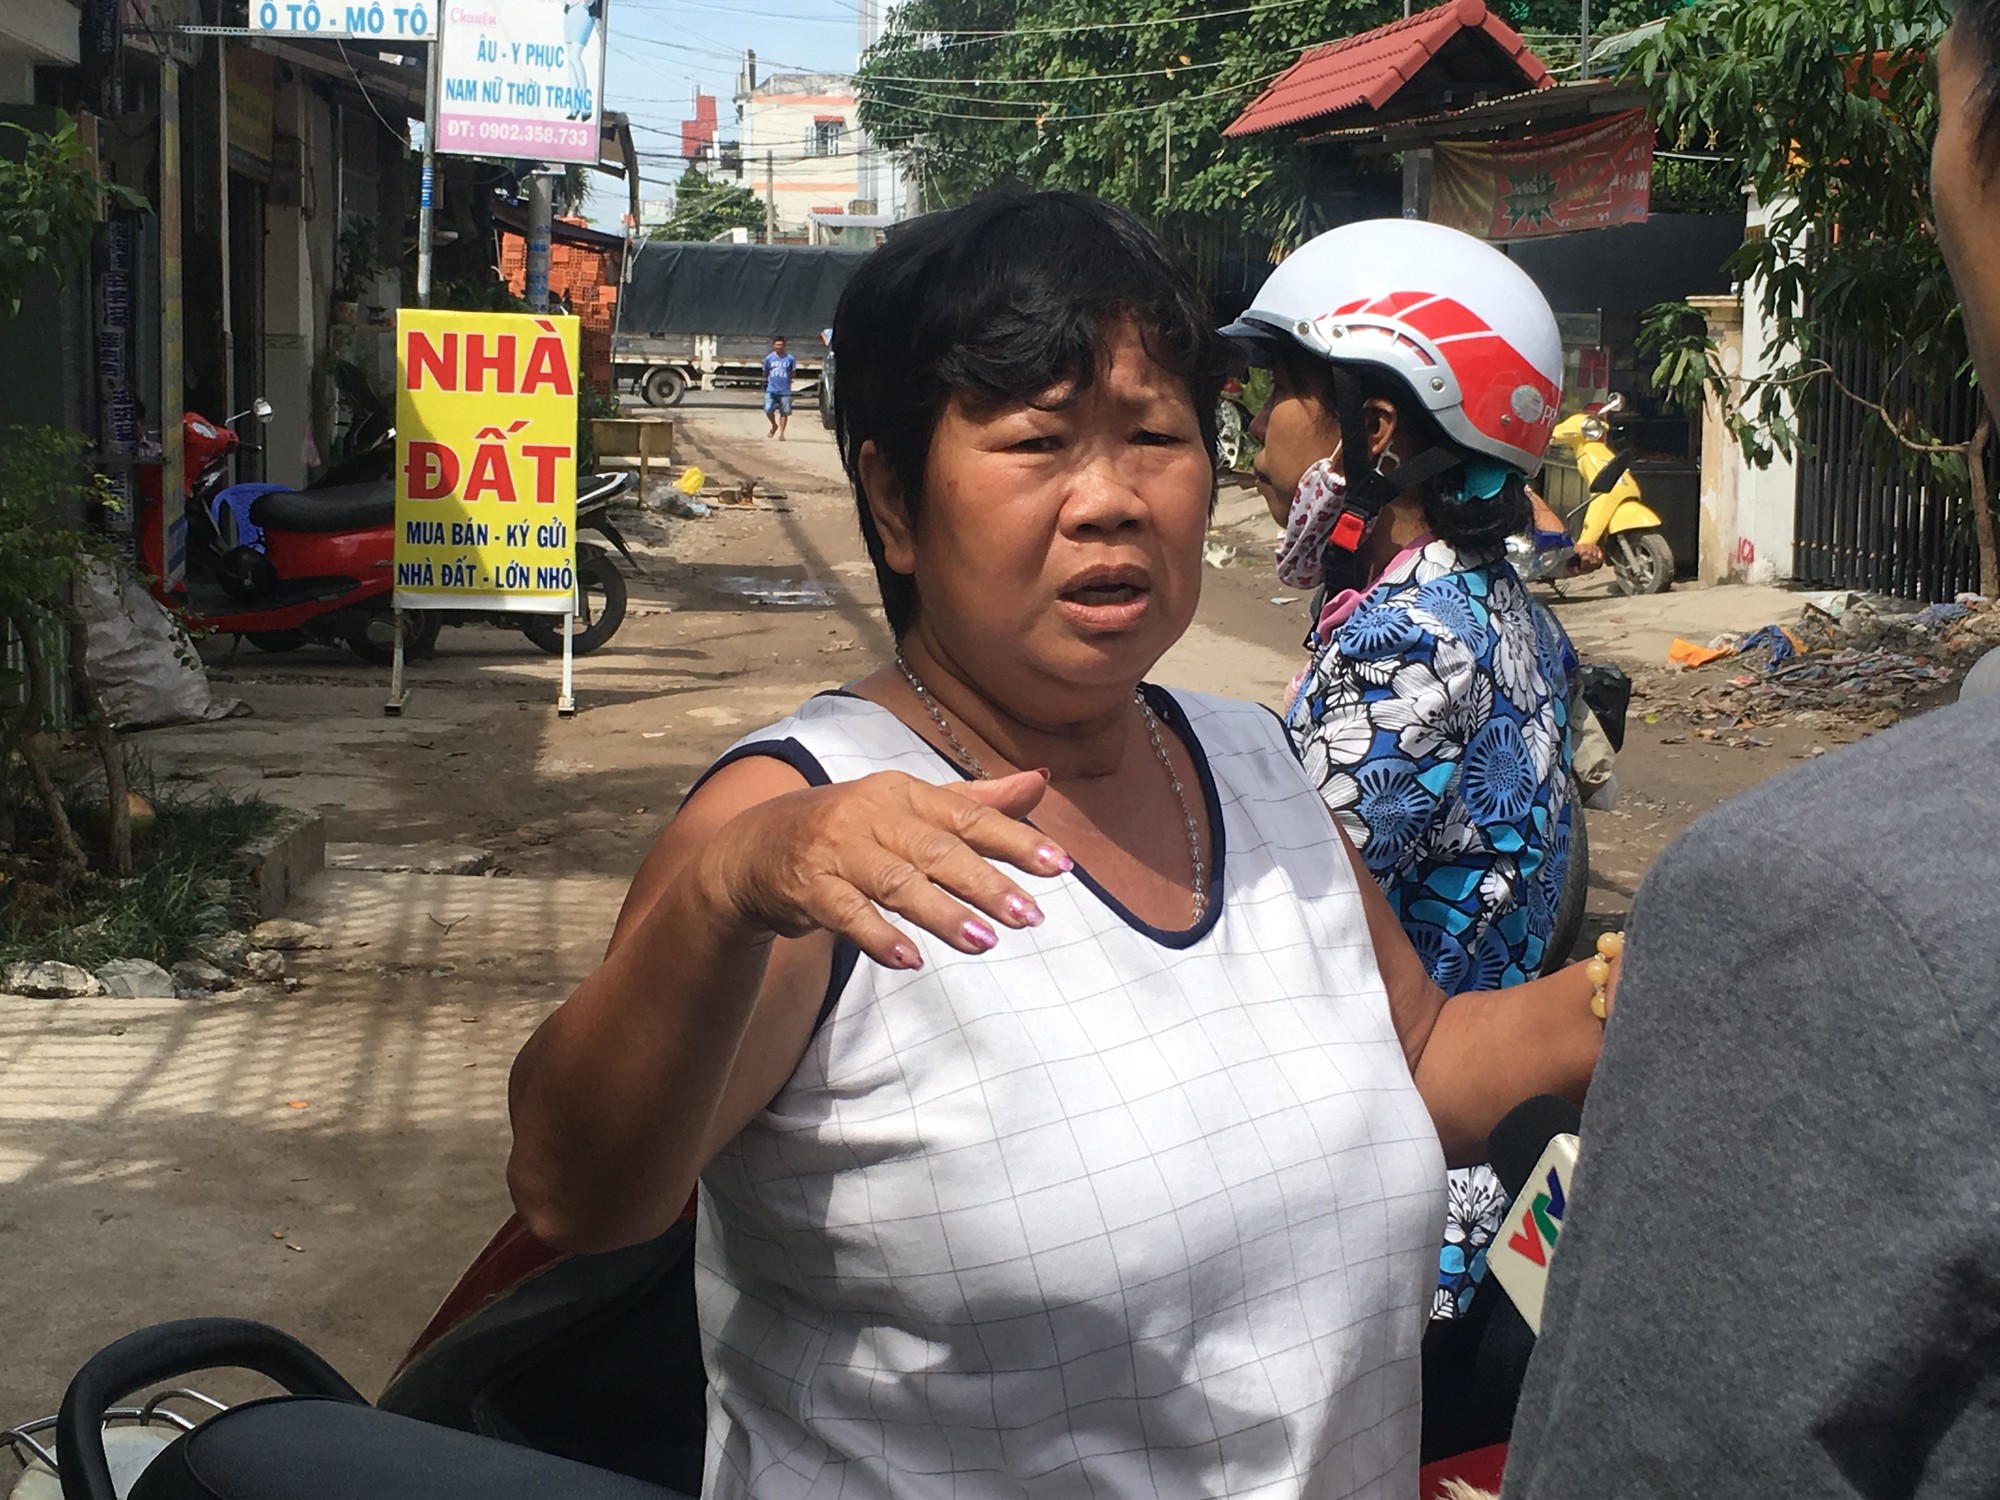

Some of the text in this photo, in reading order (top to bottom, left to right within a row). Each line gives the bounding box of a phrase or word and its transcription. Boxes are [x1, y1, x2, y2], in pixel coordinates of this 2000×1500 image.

[260, 0, 428, 36] Ô TÔ - MÔ TÔ
[477, 34, 498, 63] ÂU
[512, 42, 521, 64] Y
[526, 44, 565, 72] PHỤC
[445, 76, 593, 110] NAM NỮ THỜI TRANG
[447, 119, 588, 146] ĐT: 0902.358.733
[406, 320, 574, 395] NHÀ
[404, 420, 572, 504] ĐẤT
[406, 521, 445, 545] MUA
[452, 517, 488, 546] BÁN
[507, 518, 530, 547] KÝ
[537, 517, 567, 548] GỬI
[399, 557, 434, 586] NHÀ
[441, 555, 477, 586] ĐẤT
[495, 559, 530, 589] LỚN
[536, 558, 573, 590] NHỎ
